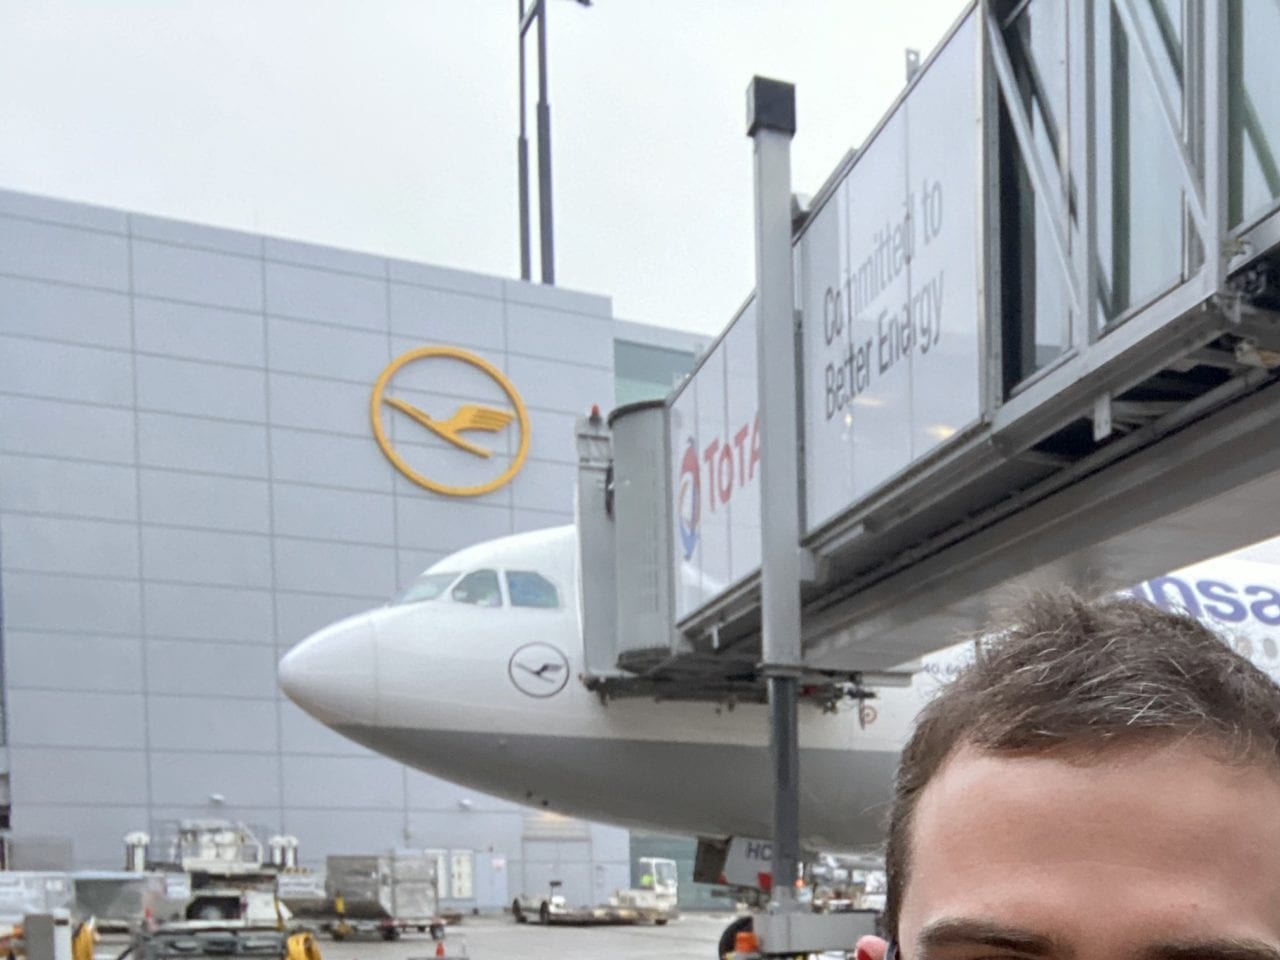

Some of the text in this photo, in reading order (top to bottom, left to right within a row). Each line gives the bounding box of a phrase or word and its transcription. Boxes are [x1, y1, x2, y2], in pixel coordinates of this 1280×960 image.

[823, 178, 943, 346] Committed to
[825, 270, 943, 421] Better Energy
